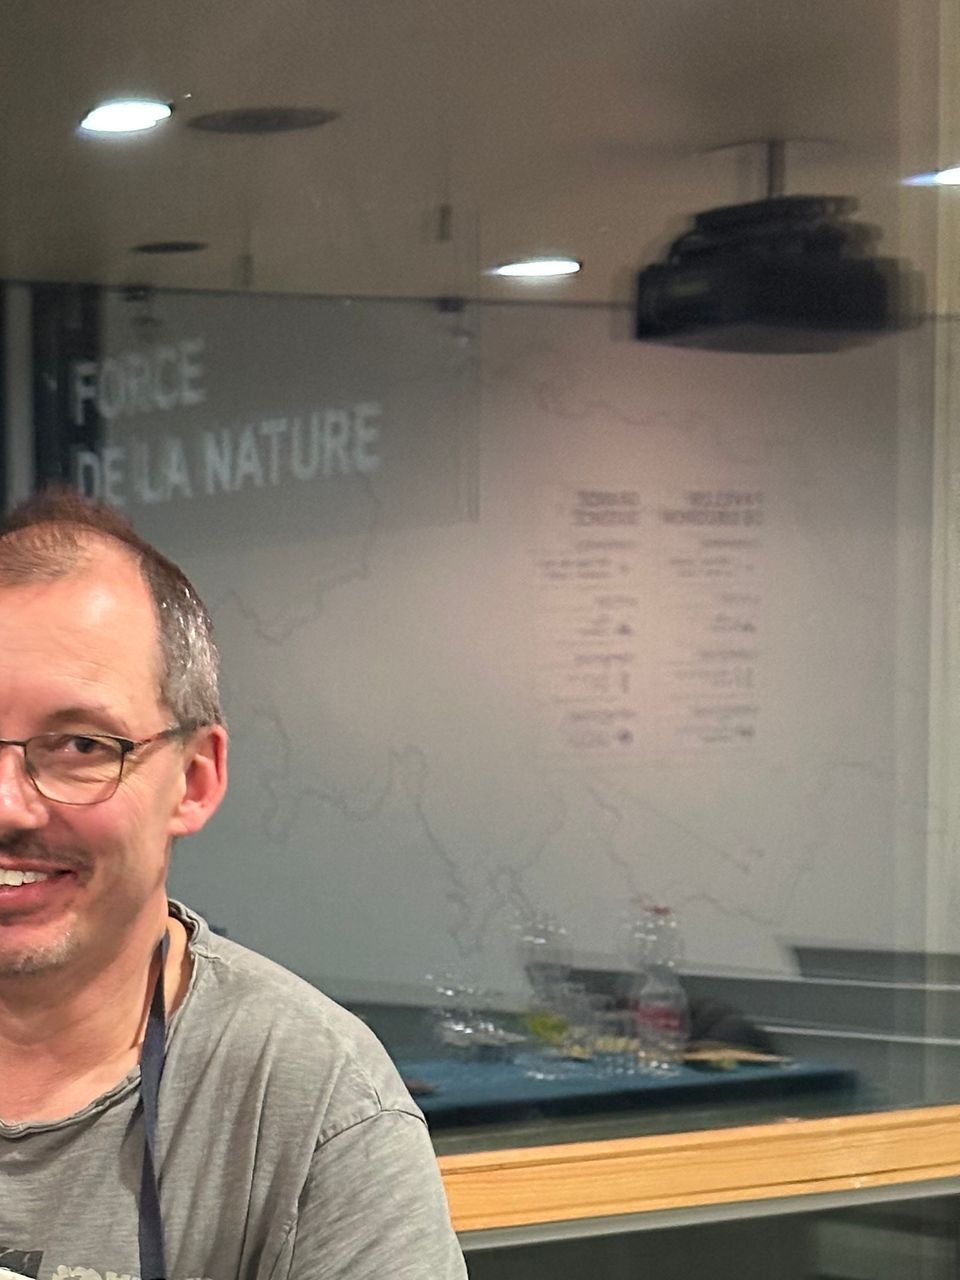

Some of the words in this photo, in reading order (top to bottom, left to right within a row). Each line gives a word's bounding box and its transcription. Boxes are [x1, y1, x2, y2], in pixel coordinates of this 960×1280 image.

[73, 338, 206, 426] FORCE
[77, 446, 129, 503] DE
[135, 436, 192, 503] LA
[204, 402, 384, 495] NATURE
